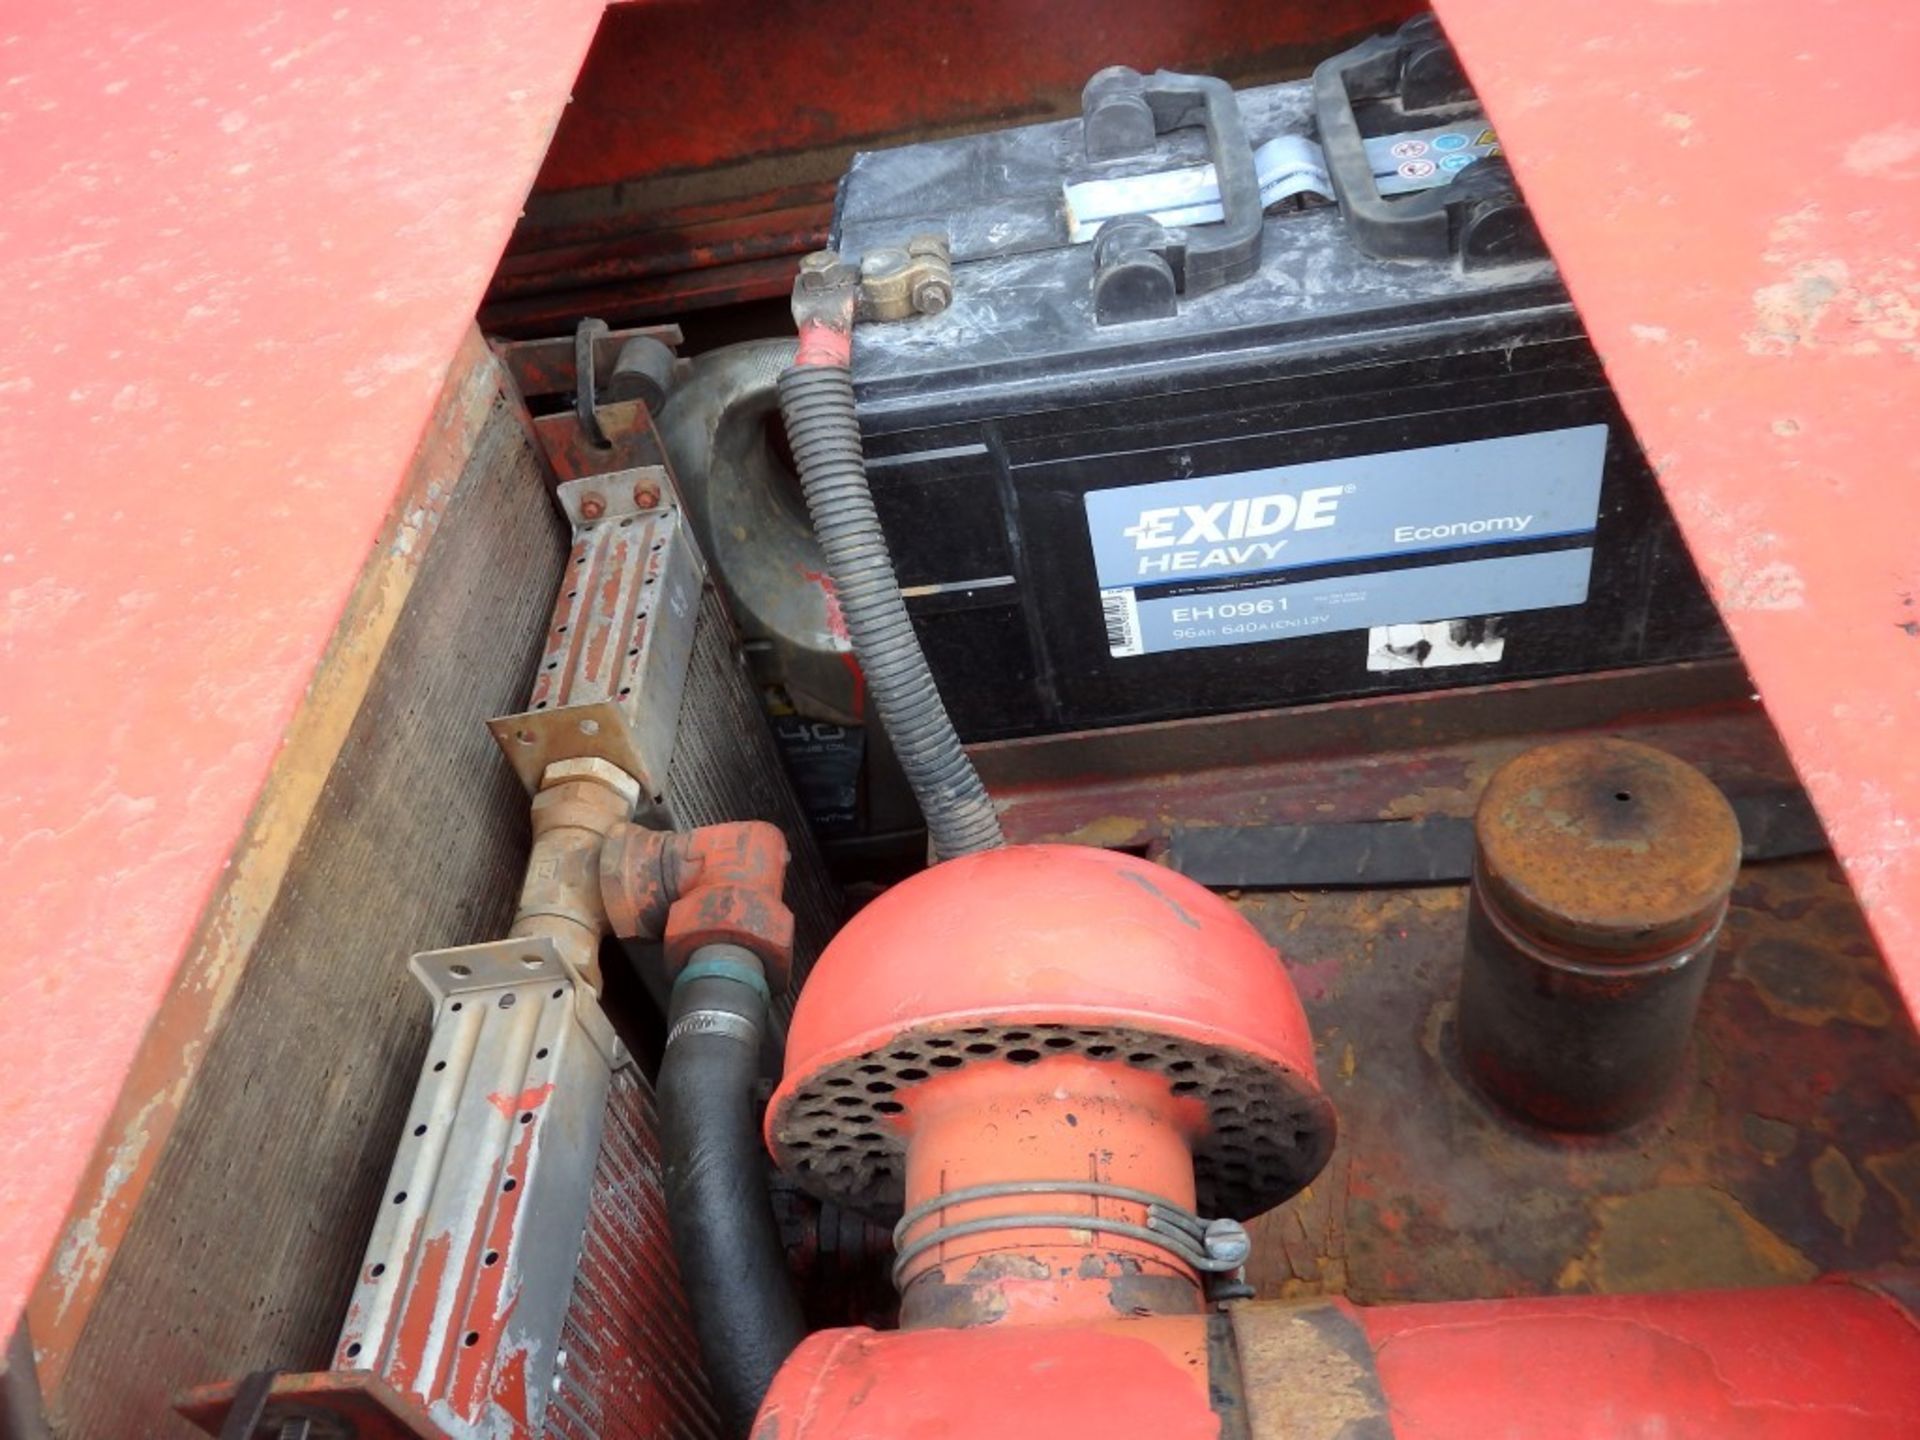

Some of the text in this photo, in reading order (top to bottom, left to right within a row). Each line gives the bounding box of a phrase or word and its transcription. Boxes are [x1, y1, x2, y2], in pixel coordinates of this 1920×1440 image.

[1123, 485, 1343, 550] EXIDE
[1394, 515, 1533, 543] Economy
[1138, 539, 1288, 574] HEAVY
[1171, 597, 1288, 623] EH0961
